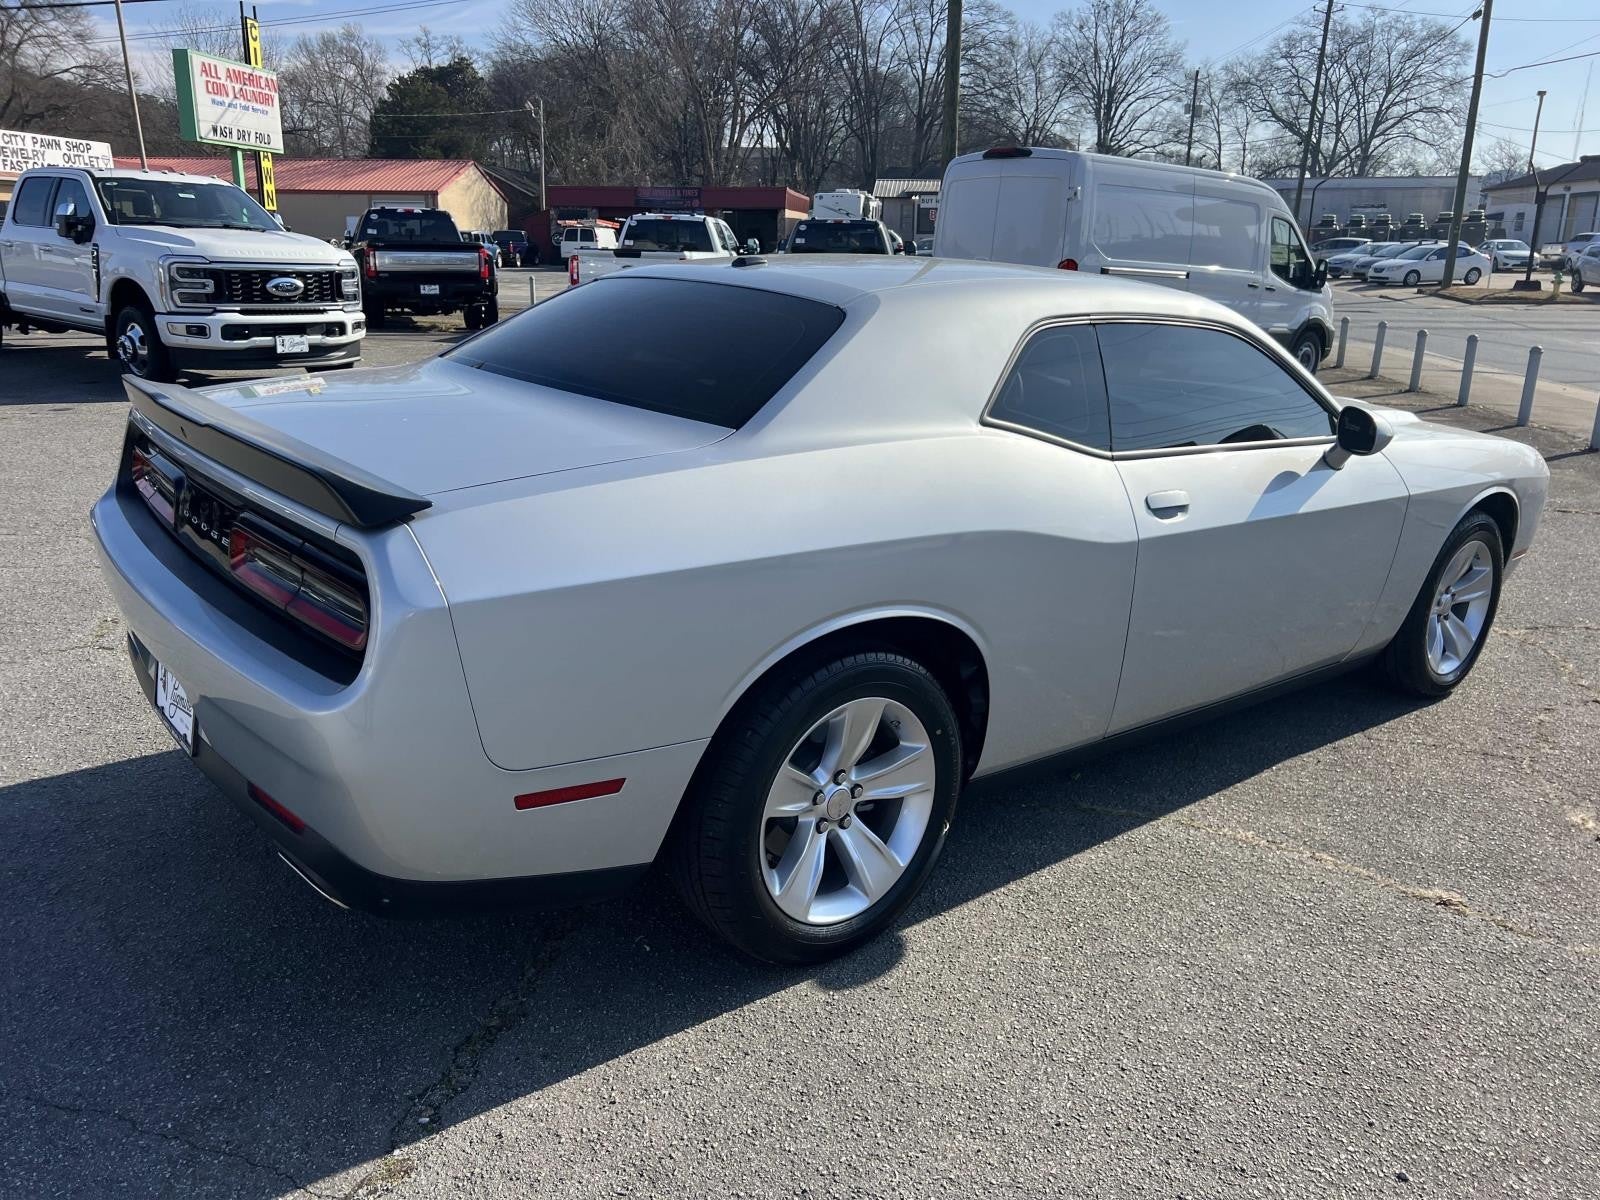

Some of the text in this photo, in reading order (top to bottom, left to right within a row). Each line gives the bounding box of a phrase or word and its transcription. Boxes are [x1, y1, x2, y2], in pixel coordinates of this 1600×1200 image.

[200, 61, 278, 93] ALL AMERICAN
[205, 80, 275, 107] COIN LAUNDRY
[211, 98, 269, 116] Wash and Fold Service
[2, 133, 92, 154] CITY PAWN SHOP
[211, 125, 272, 145] WASH DRY FOLD
[0, 146, 46, 162] EWELRY
[62, 153, 99, 168] OUTLET
[3, 159, 30, 172] FAST
[183, 510, 229, 547] DODGE
